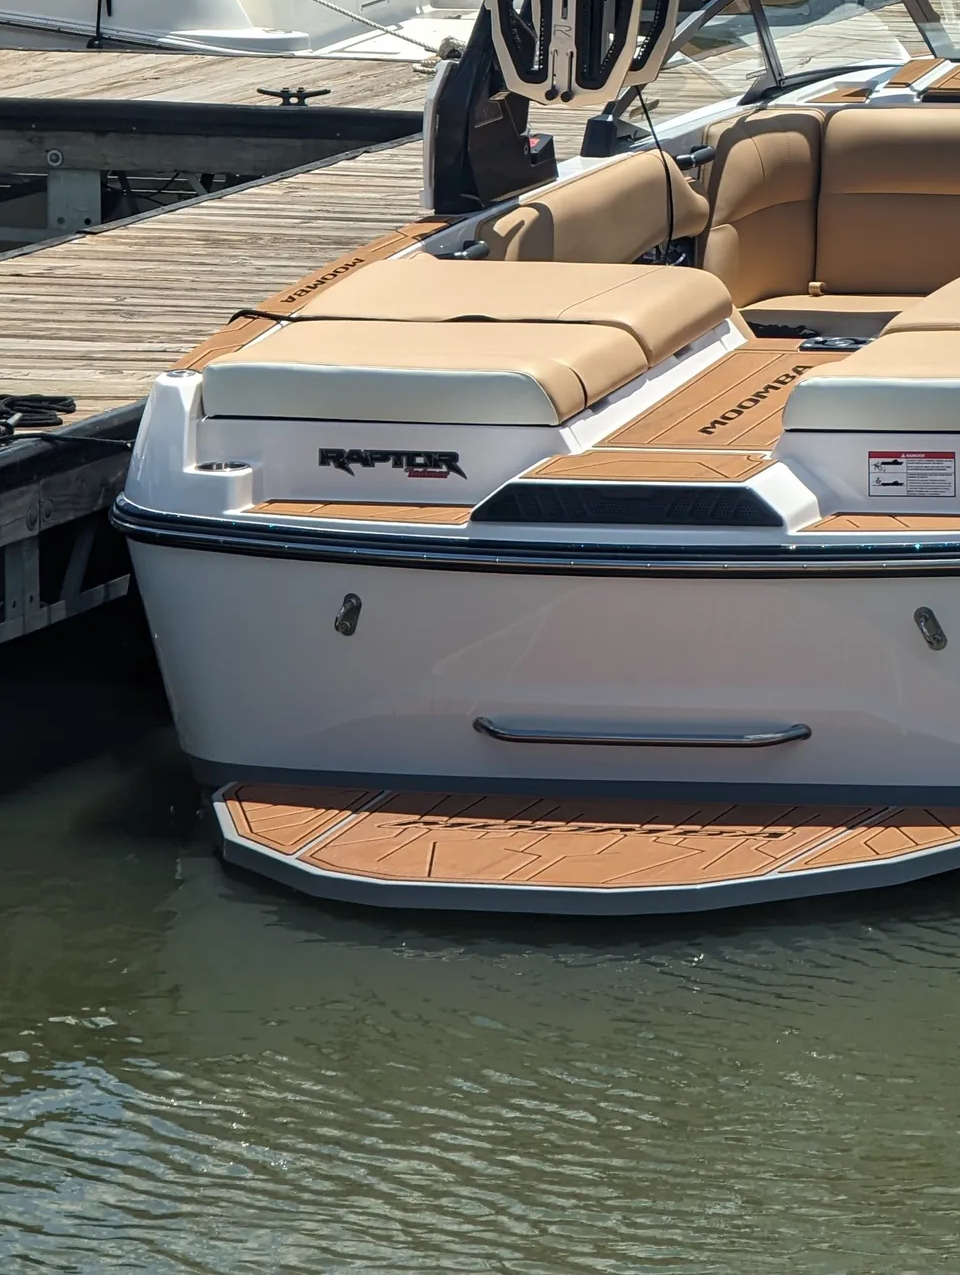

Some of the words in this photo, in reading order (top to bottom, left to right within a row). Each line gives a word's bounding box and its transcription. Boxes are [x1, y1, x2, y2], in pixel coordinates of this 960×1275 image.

[280, 257, 366, 304] MOOMBA
[697, 364, 814, 436] MOOMBA
[318, 447, 468, 480] RAPTOR
